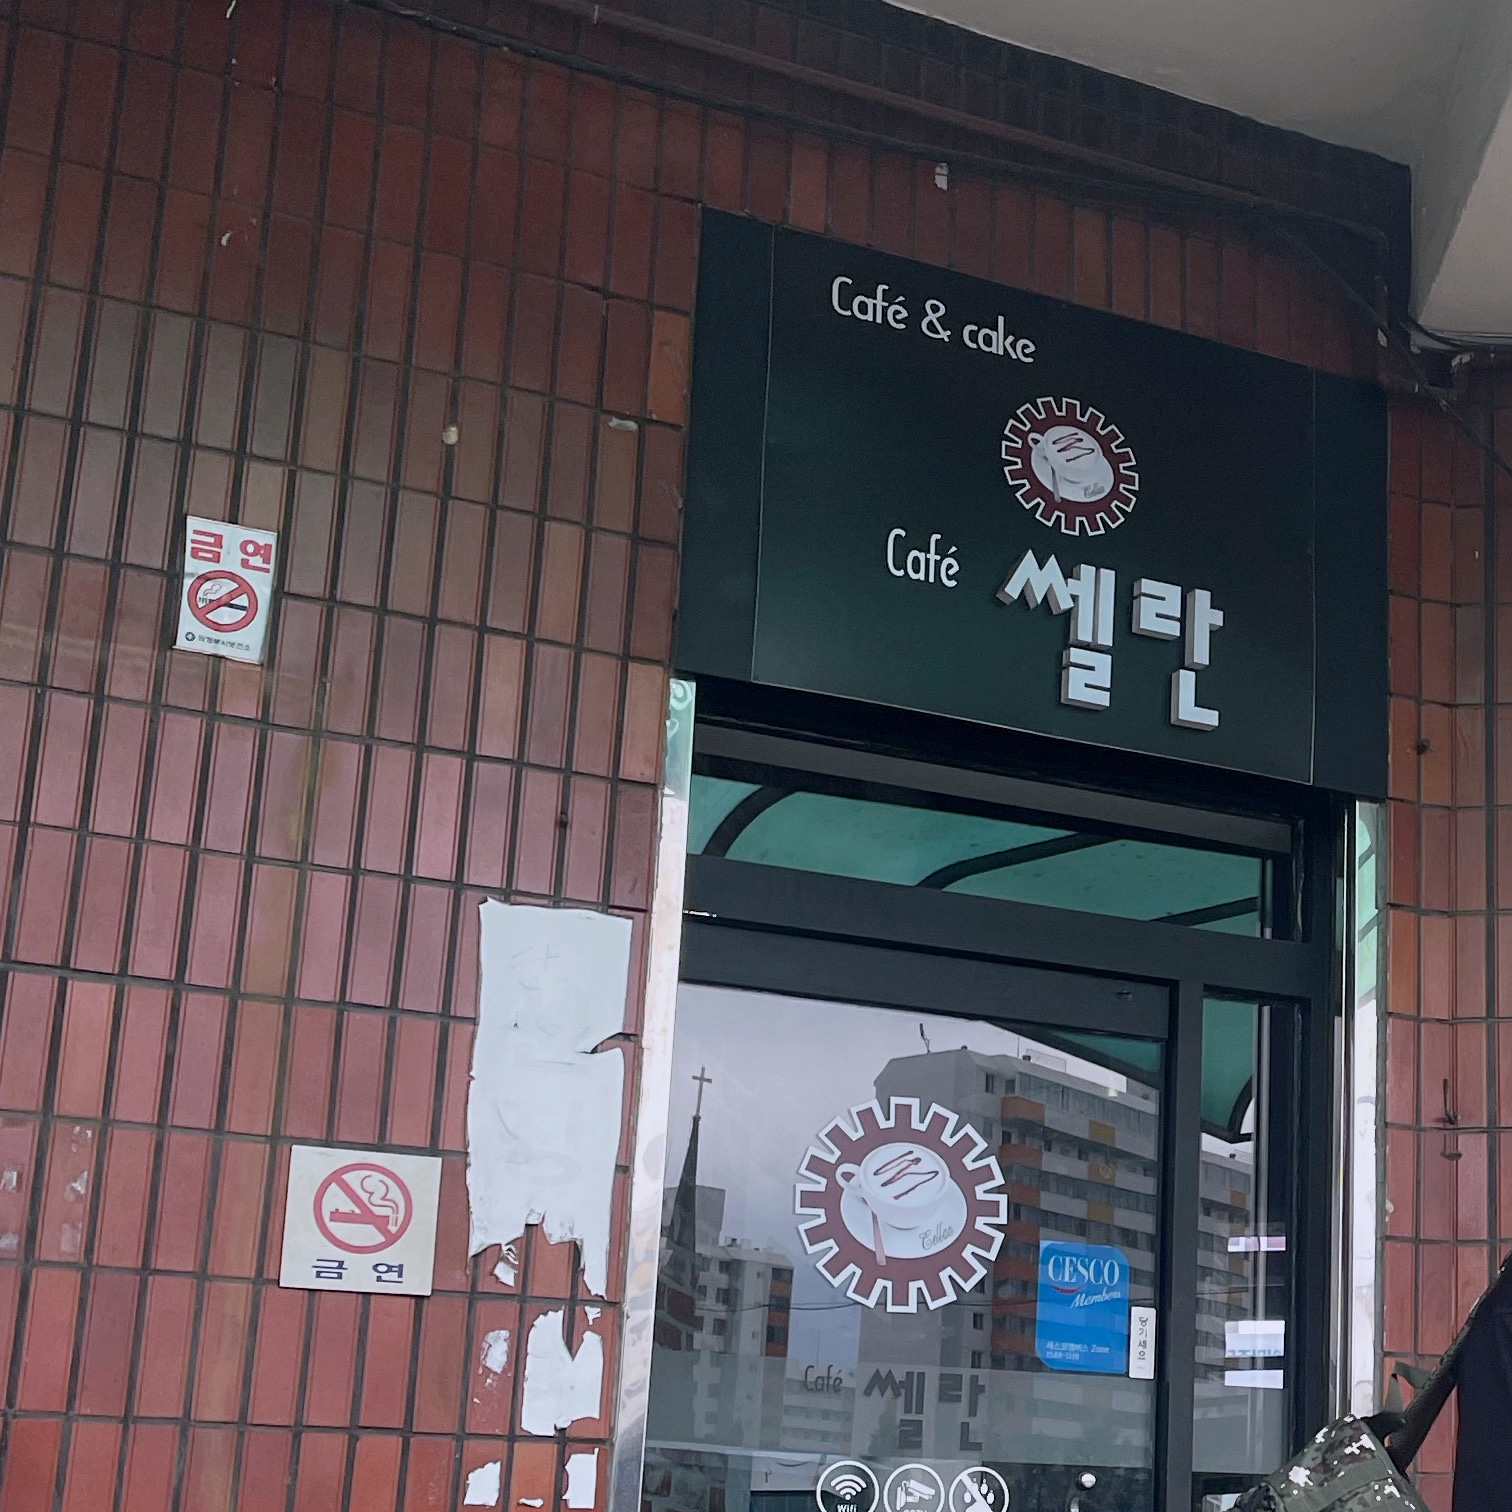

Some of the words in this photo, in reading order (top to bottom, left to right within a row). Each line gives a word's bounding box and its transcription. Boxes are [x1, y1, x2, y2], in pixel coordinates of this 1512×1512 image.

[831, 276, 908, 330] Café
[921, 299, 952, 341] &
[962, 316, 1037, 363] cake
[886, 527, 960, 588] Café
[996, 549, 1224, 731] 쎌란
[1048, 1255, 1120, 1287] CESCO
[1069, 1286, 1122, 1309] Members
[1137, 1316, 1149, 1361] 당기세요
[804, 1365, 843, 1394] Café
[864, 1368, 986, 1451] 쎌란
